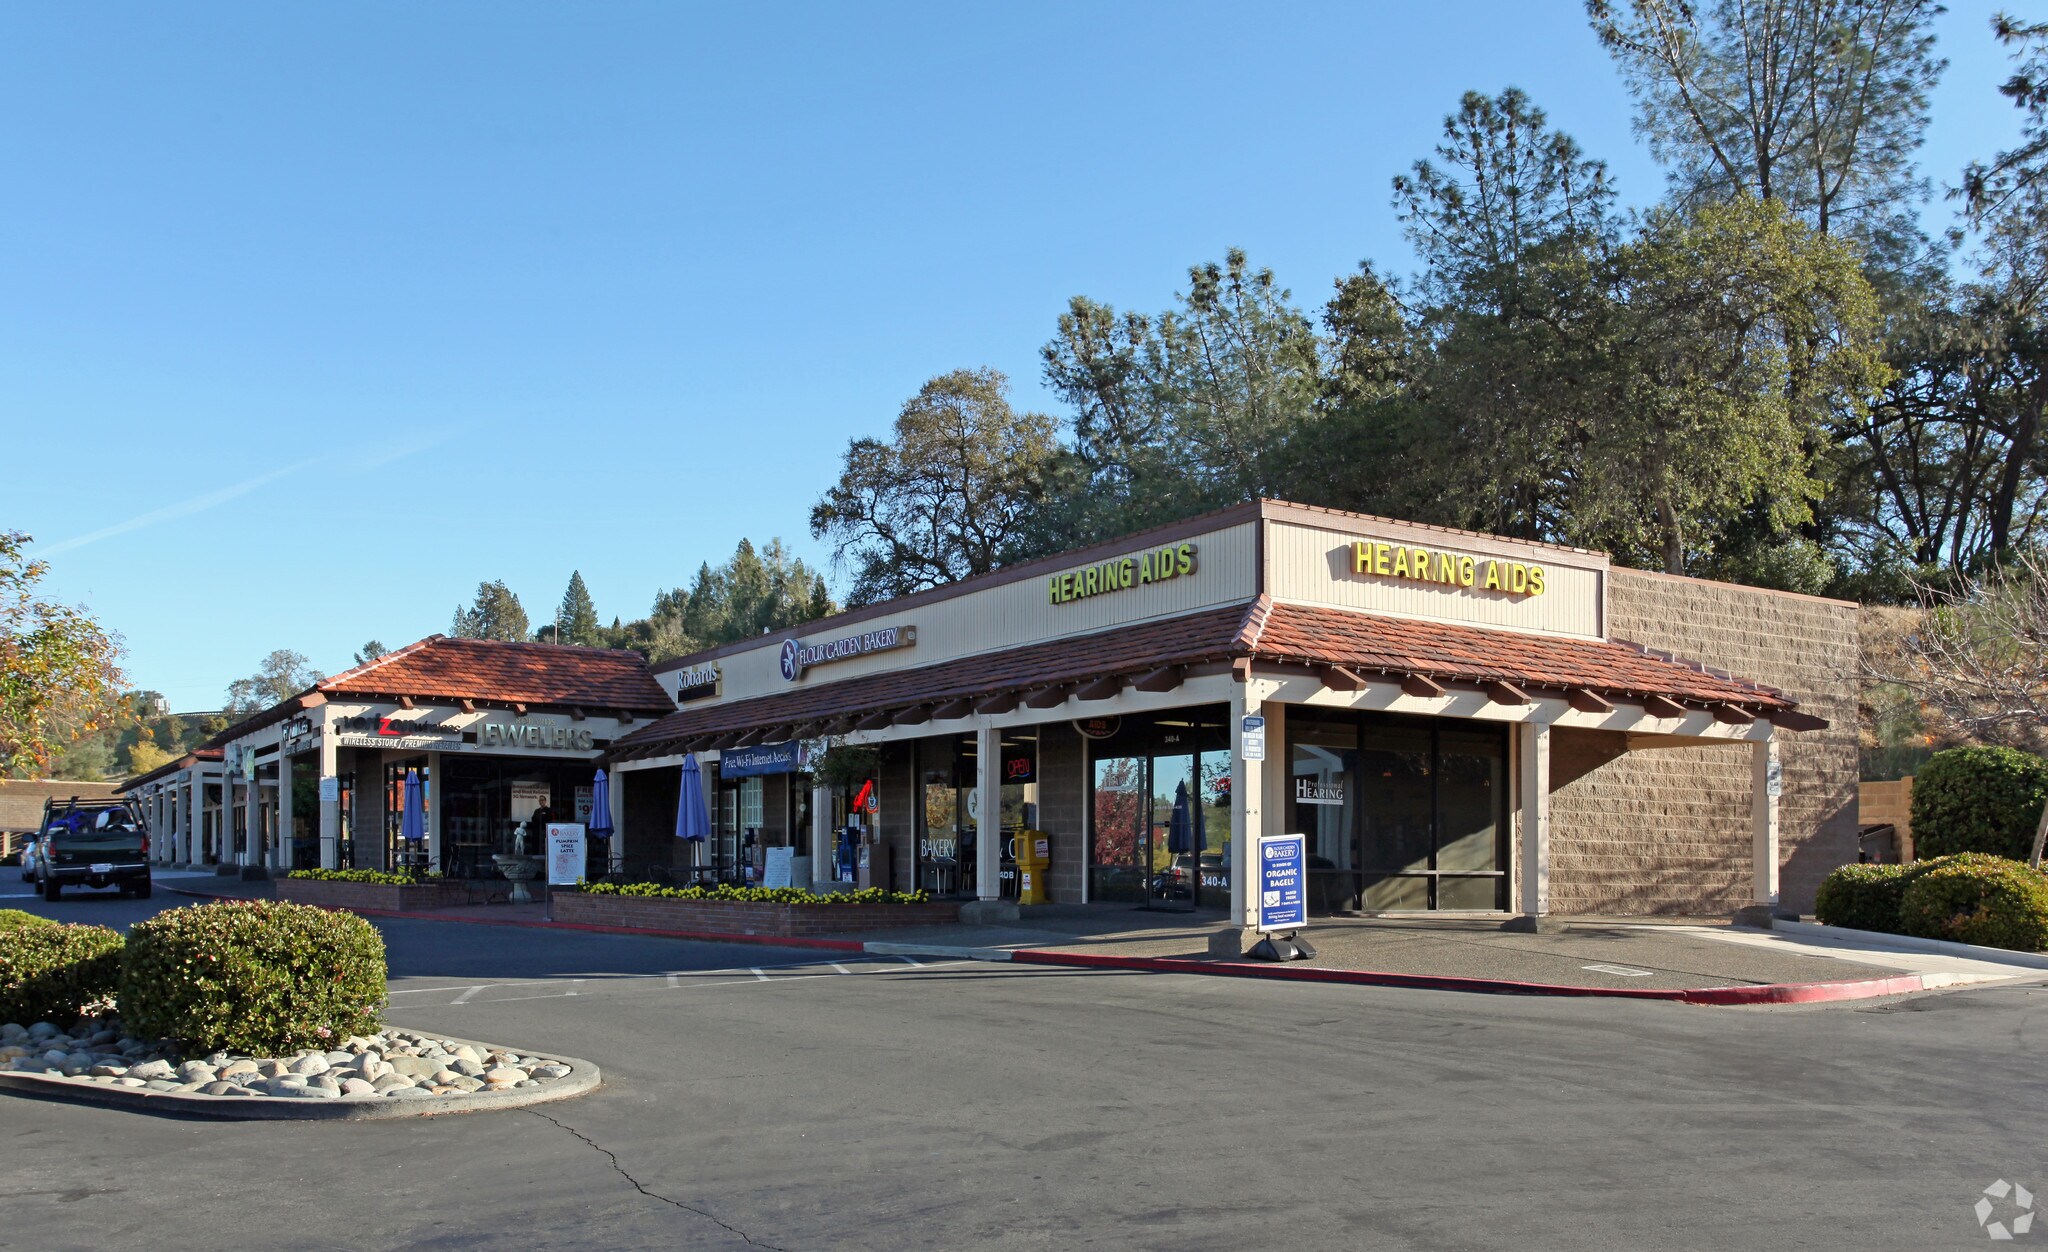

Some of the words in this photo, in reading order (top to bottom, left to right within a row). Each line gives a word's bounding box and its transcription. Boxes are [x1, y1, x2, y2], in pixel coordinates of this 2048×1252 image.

[1049, 557, 1135, 604] HEARING
[1140, 543, 1196, 584] AIDS
[1355, 541, 1475, 587] HEARING
[1484, 559, 1545, 596] AIDS
[799, 644, 825, 665] FLOUR
[825, 635, 861, 659] GARDEN
[864, 627, 898, 651] BAKERY
[677, 666, 718, 689] Robards
[1088, 719, 1107, 729] AIDS
[343, 736, 376, 747] WIRELESS
[474, 723, 594, 751] JEWELERS
[1164, 735, 1180, 743] 340-A
[724, 757, 736, 768] Free
[736, 753, 751, 768] Wi-Fi
[752, 753, 772, 766] Internet
[773, 751, 792, 764] Access
[1007, 758, 1031, 775] OPEN
[1296, 778, 1344, 800] HEARING
[1307, 779, 1344, 789] Professional
[921, 838, 957, 857] BAKERY
[1273, 850, 1296, 858] BAKERY
[1201, 876, 1228, 887] 340-A
[1266, 868, 1298, 878] ORGANIC
[1270, 878, 1294, 887] BAGELS
